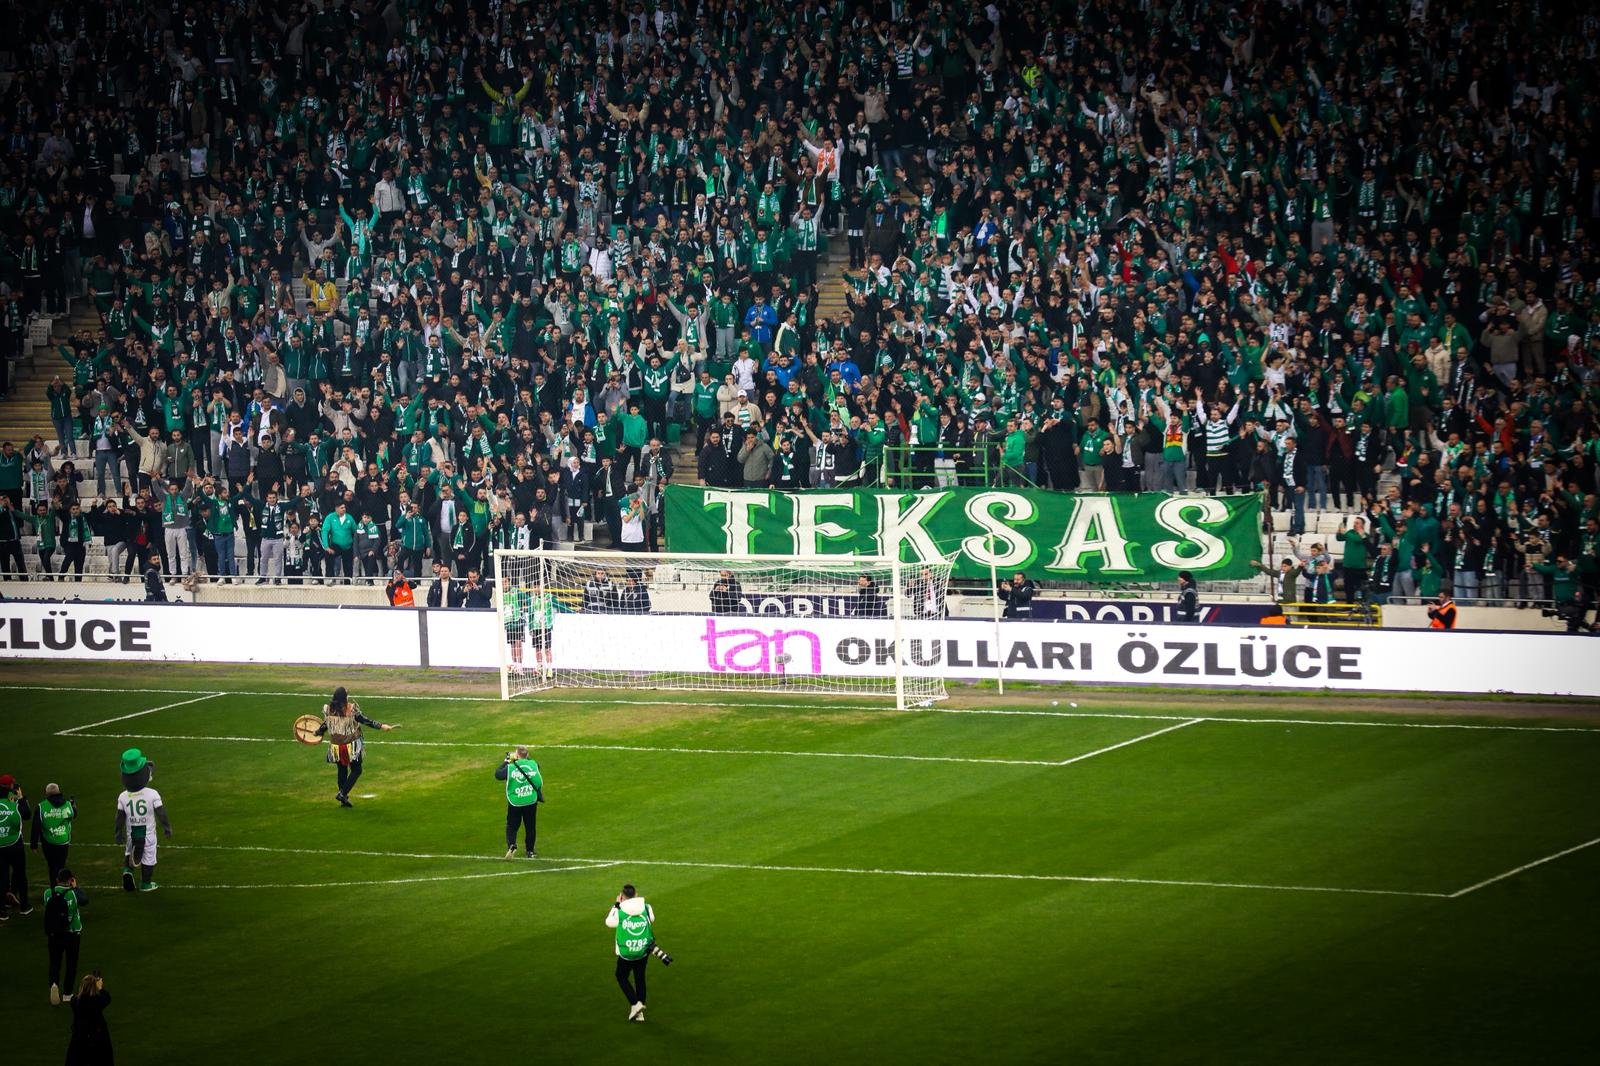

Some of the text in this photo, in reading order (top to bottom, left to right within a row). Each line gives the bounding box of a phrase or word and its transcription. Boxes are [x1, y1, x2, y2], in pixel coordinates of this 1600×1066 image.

[703, 490, 1232, 572] TEKSAS
[0, 610, 152, 652] LÜCE
[700, 618, 1362, 680] tan OKULLARI ÖZLÜCE
[126, 799, 148, 817] 16
